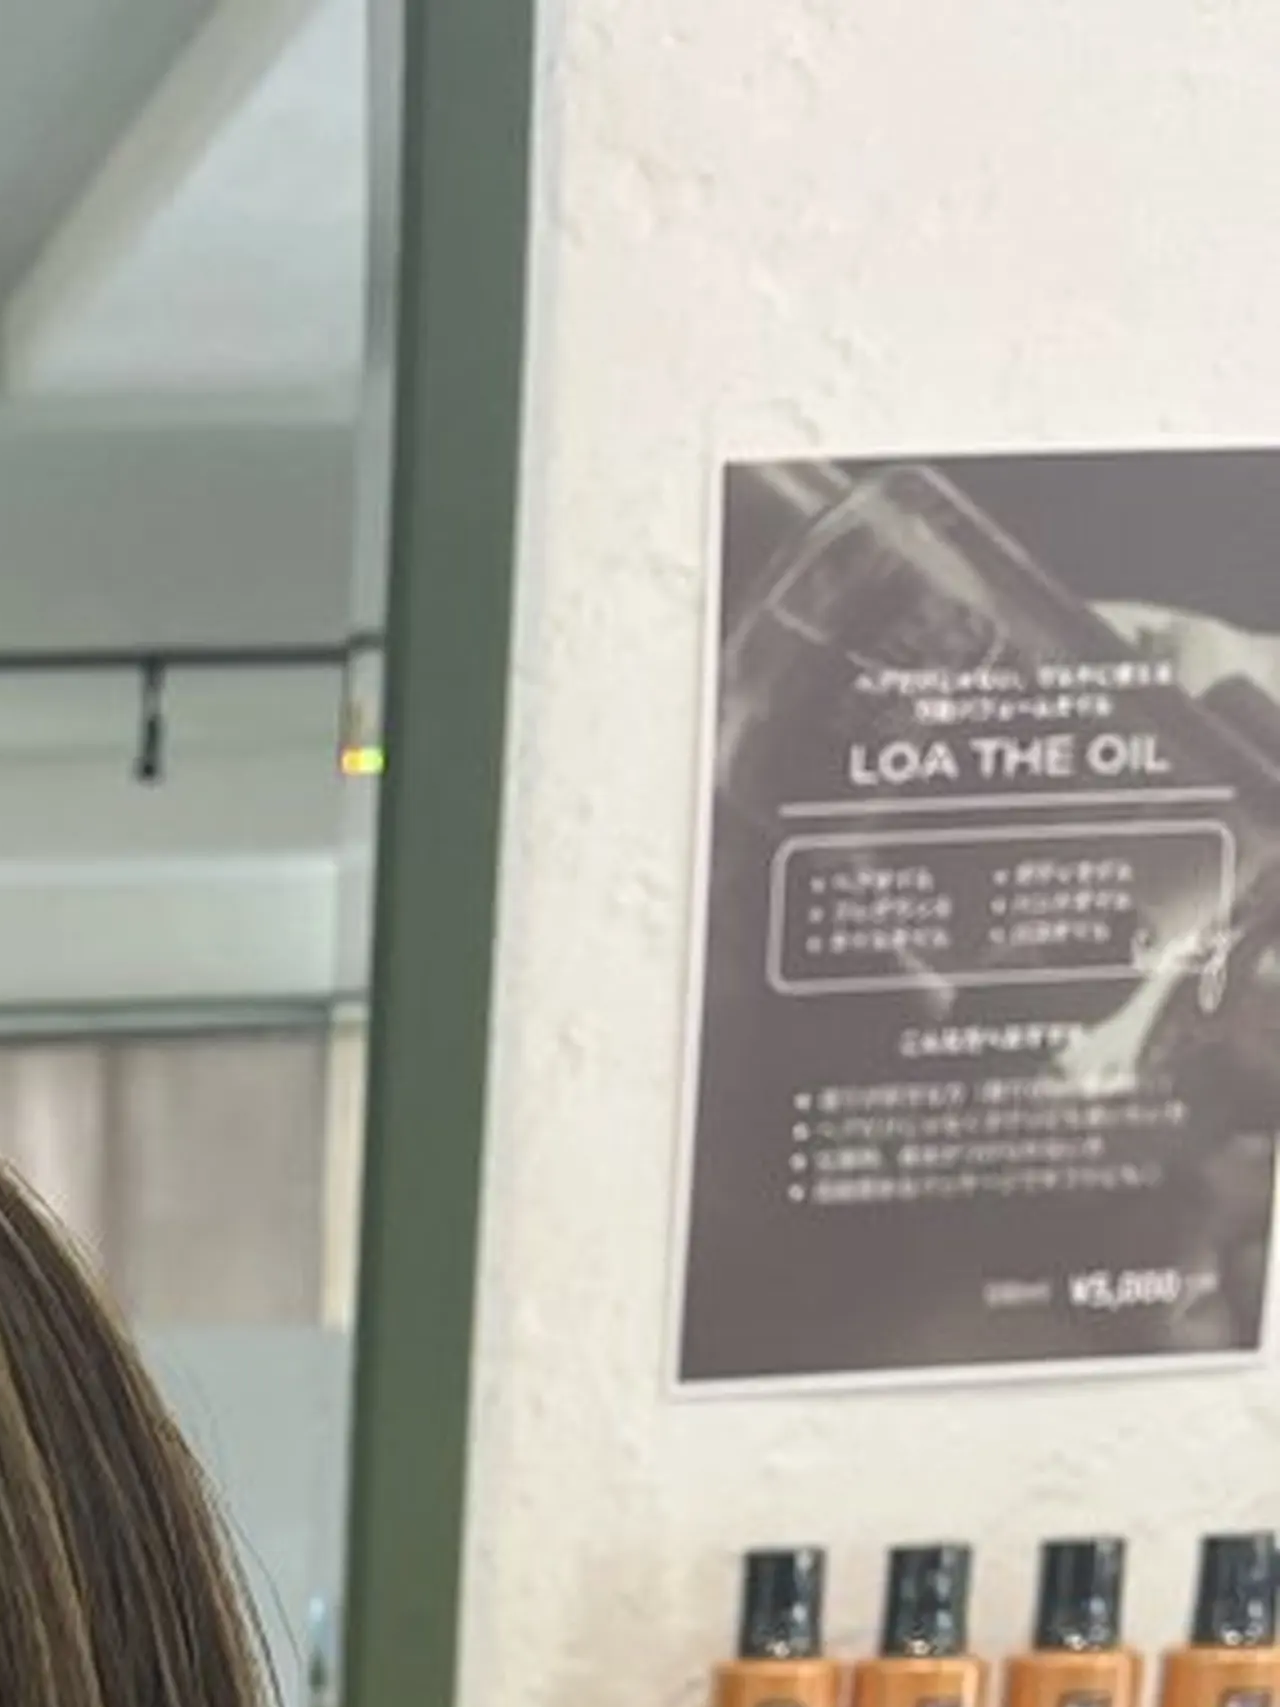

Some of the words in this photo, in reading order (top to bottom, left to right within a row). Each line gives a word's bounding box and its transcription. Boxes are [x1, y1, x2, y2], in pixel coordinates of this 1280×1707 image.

[850, 740, 960, 785] LOA
[969, 734, 1077, 780] THE
[1085, 732, 1173, 776] OIL
